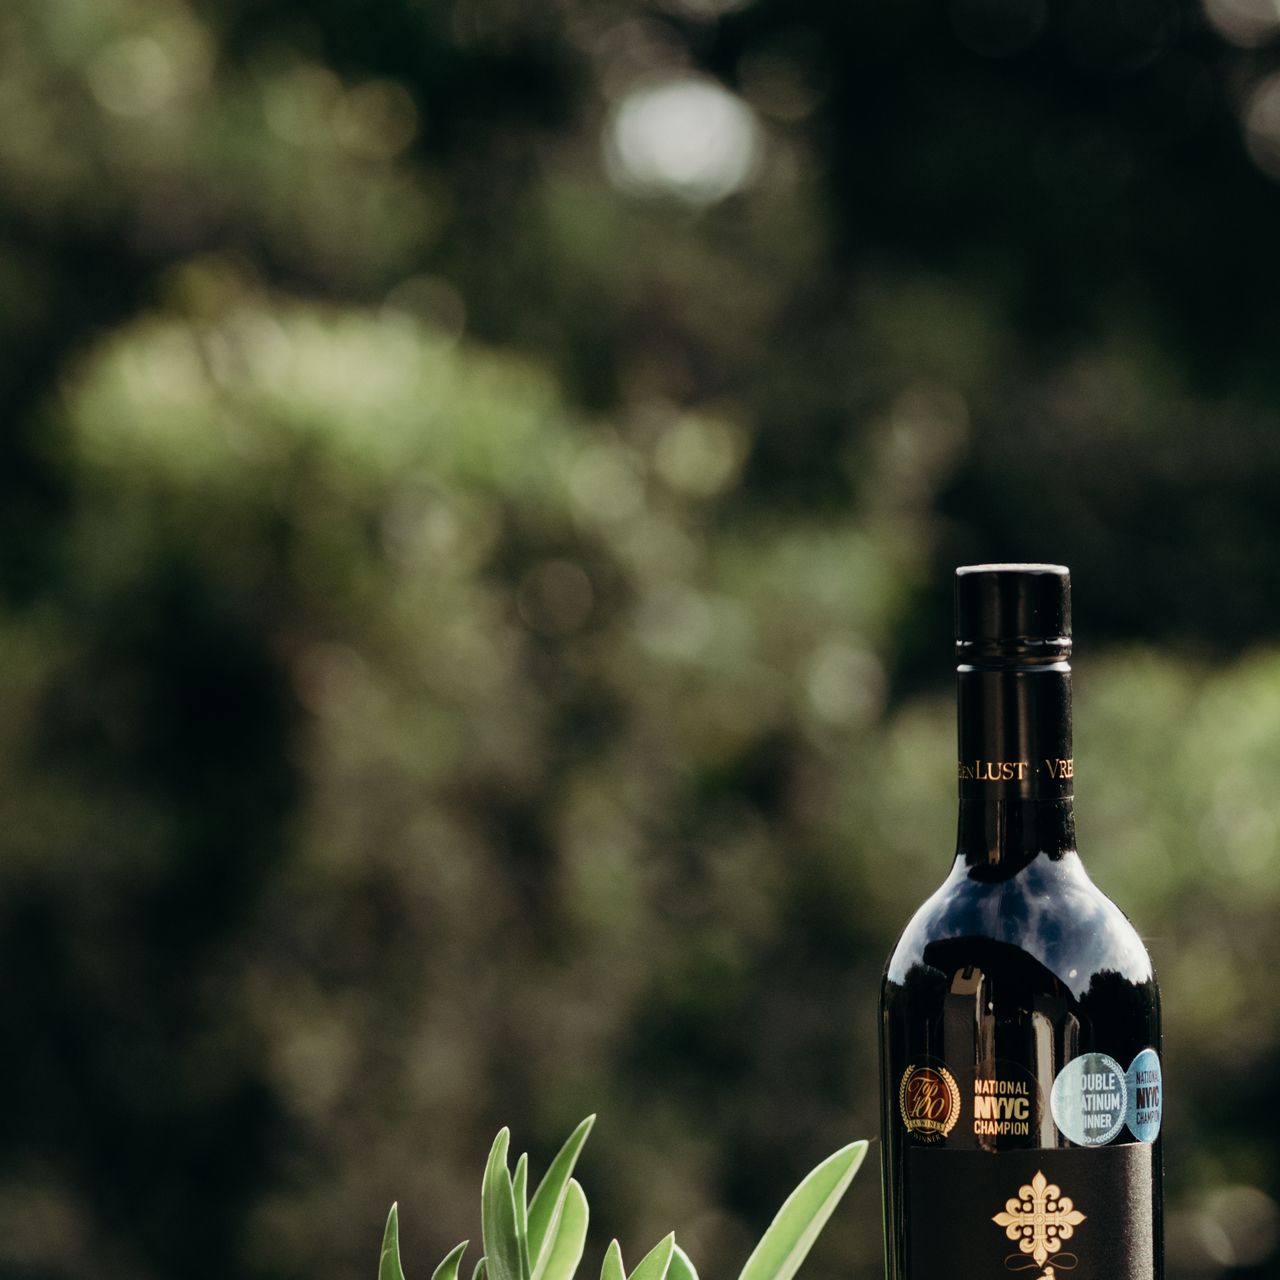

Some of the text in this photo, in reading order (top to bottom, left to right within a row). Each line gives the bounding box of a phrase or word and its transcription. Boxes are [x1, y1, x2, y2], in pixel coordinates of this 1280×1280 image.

[976, 760, 1028, 780] LUST
[1046, 759, 1073, 779] VRE
[974, 1079, 1029, 1095] NATIONAL
[1081, 1073, 1116, 1090] OUBLE
[1082, 1092, 1120, 1111] ATINUM
[974, 1120, 1029, 1136] CHAMPION
[1083, 1113, 1112, 1129] INNER
